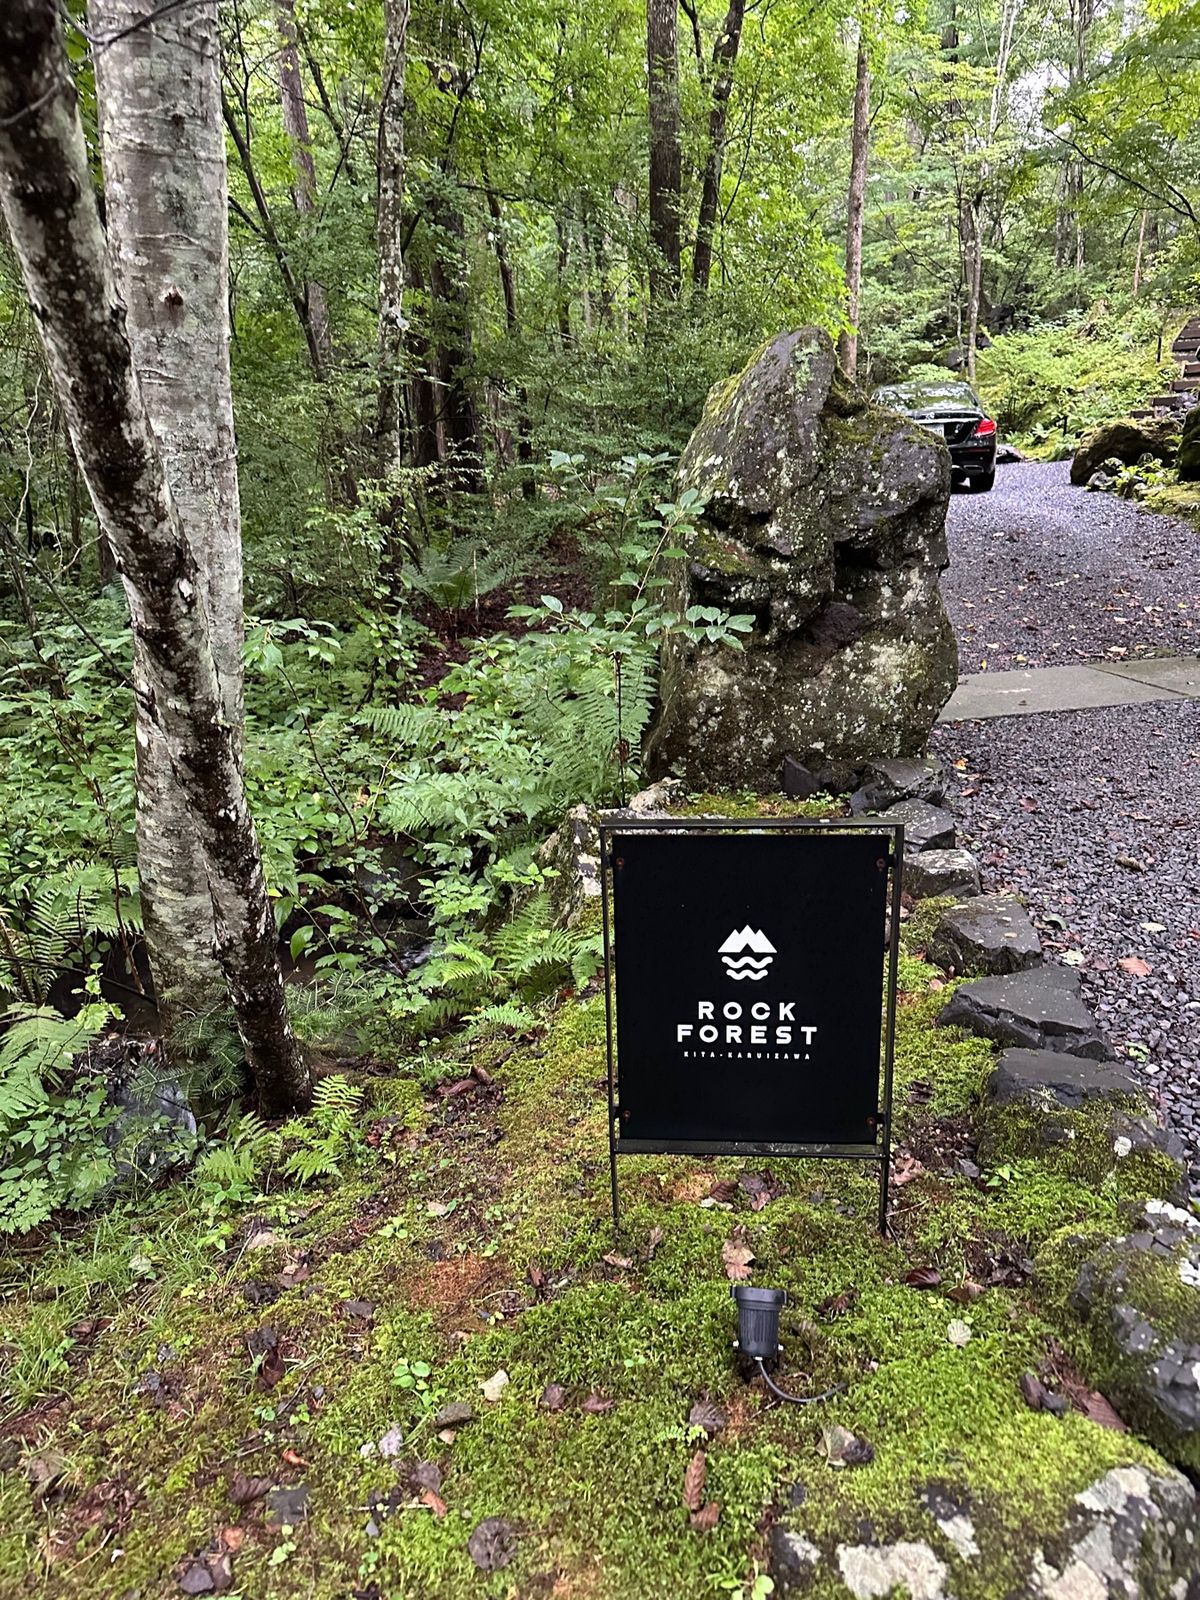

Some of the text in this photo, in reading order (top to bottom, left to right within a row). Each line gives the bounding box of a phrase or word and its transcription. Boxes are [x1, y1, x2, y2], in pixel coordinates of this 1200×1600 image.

[698, 1001, 796, 1021] ROCK
[677, 1024, 818, 1045] FOREST
[683, 1050, 810, 1060] KITA-KARUIZAWA
